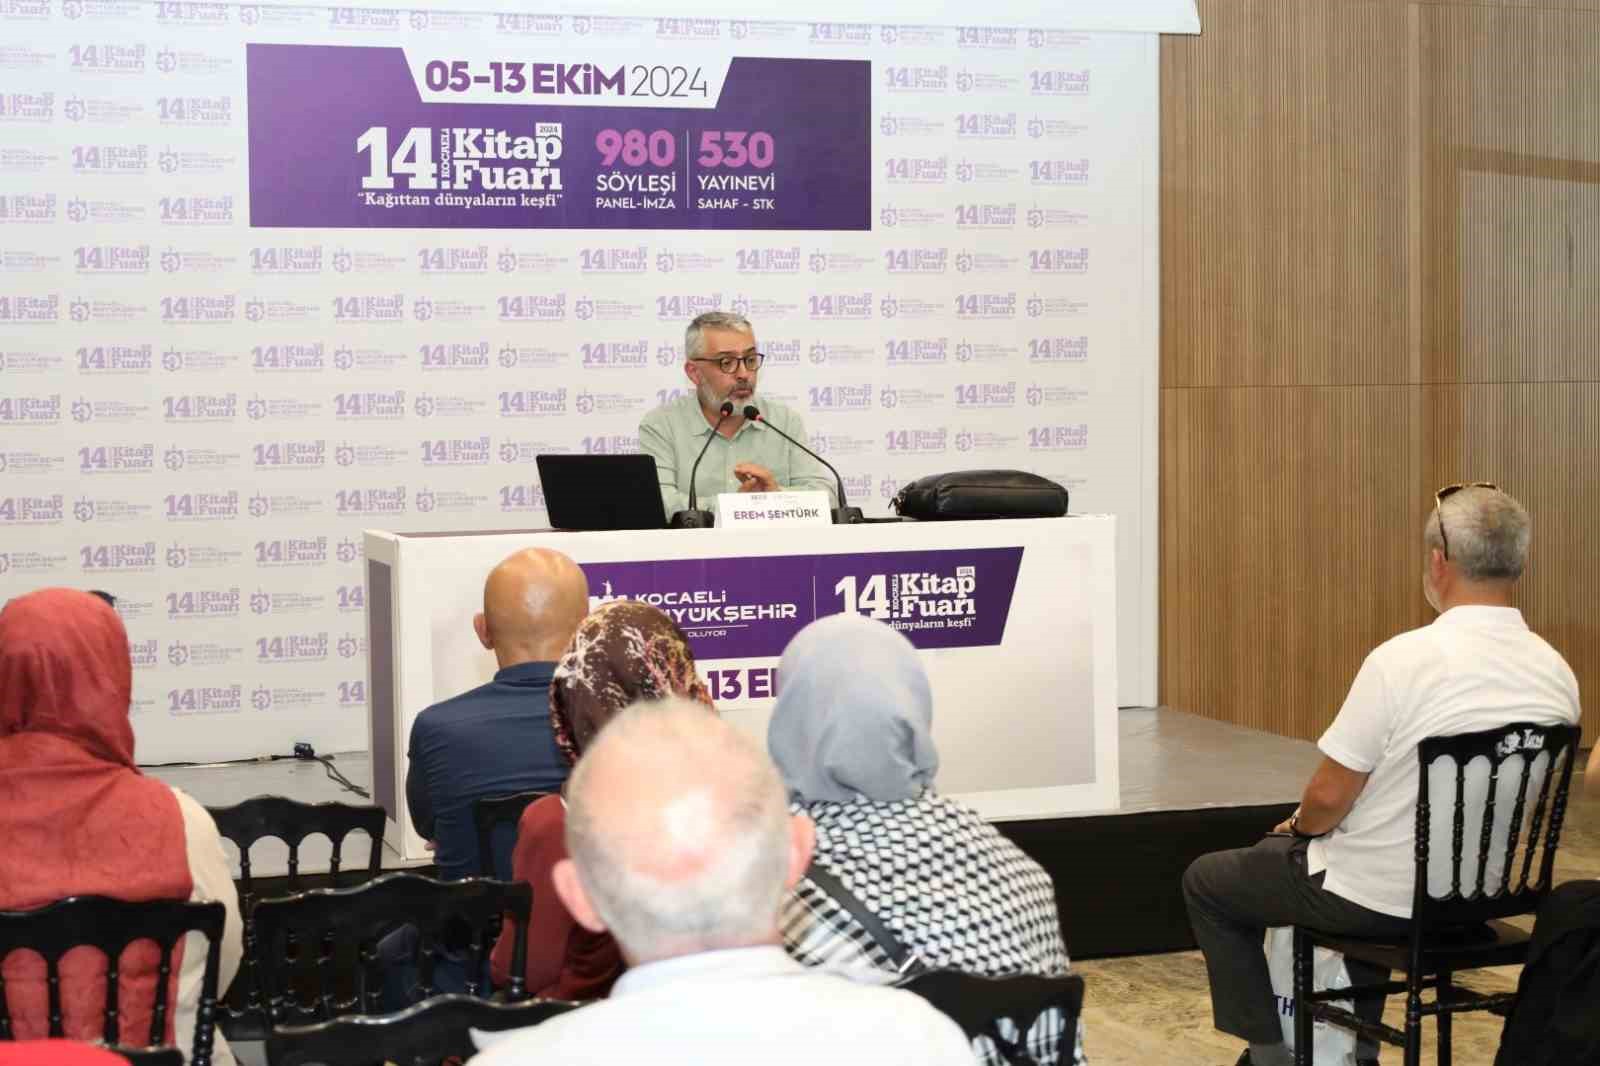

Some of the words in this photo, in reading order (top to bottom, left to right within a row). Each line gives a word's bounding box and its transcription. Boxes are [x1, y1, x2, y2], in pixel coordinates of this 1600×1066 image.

[631, 65, 708, 97] 2024
[453, 127, 563, 167] Kitap
[596, 129, 675, 167] 980
[698, 130, 774, 168] 530
[453, 160, 563, 190] Fuarı
[596, 171, 676, 196] SÖYLEŞİ
[698, 172, 775, 191] YAYINEVİ
[434, 193, 516, 208] dünyaların
[698, 198, 738, 209] SAHAF
[753, 199, 775, 210] STK
[734, 510, 765, 520] EREM
[900, 572, 976, 598] Kitap
[901, 595, 976, 618] Fuarı
